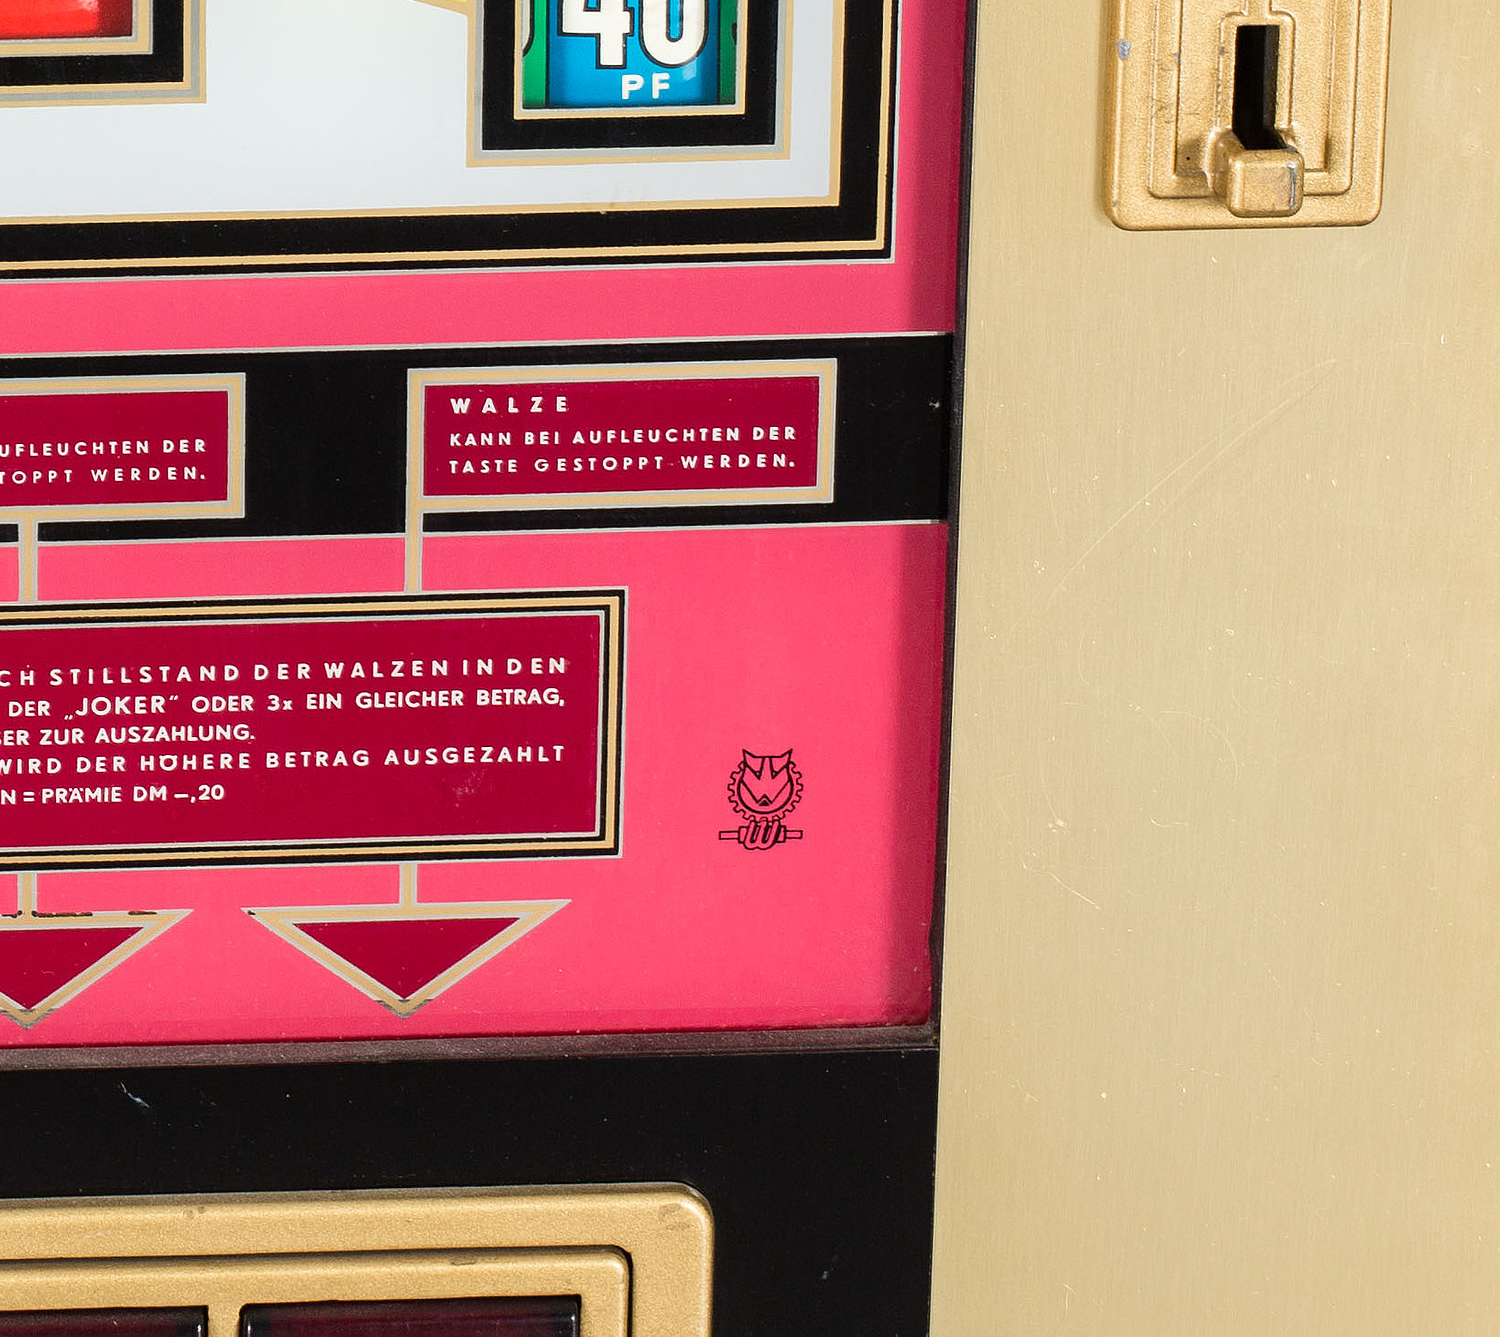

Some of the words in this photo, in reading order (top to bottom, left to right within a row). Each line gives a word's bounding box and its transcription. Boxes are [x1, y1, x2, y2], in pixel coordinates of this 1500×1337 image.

[621, 72, 670, 100] PF
[450, 396, 567, 414] WALZE
[162, 438, 206, 453] DER
[450, 432, 511, 447] KANN
[524, 431, 559, 445] BEI
[572, 427, 739, 444] AUFLEUCHTEN
[752, 426, 796, 441] DER
[90, 466, 205, 482] WERDEN.
[449, 459, 517, 474] TASTE
[534, 456, 663, 472] GESTOPPT
[680, 453, 795, 469] WERDEN.
[49, 664, 239, 686] STILLSTAND
[254, 663, 311, 681] DER
[323, 659, 448, 679] WALZEN
[462, 658, 493, 676] IN
[507, 657, 565, 675] DEN
[8, 700, 51, 717] DER
[191, 694, 254, 713] ODER
[306, 692, 342, 710] EIN
[355, 689, 464, 709] GLEICHER
[476, 687, 565, 707] BETRAG,
[39, 728, 84, 746] ZUR
[94, 723, 255, 744] AUSZAHLUNG.
[76, 755, 126, 773] DER
[266, 749, 369, 769] BETRAG
[384, 745, 564, 766] AUSGEZAHLT
[41, 786, 122, 804] PRÄMIE
[133, 785, 167, 802] DM
